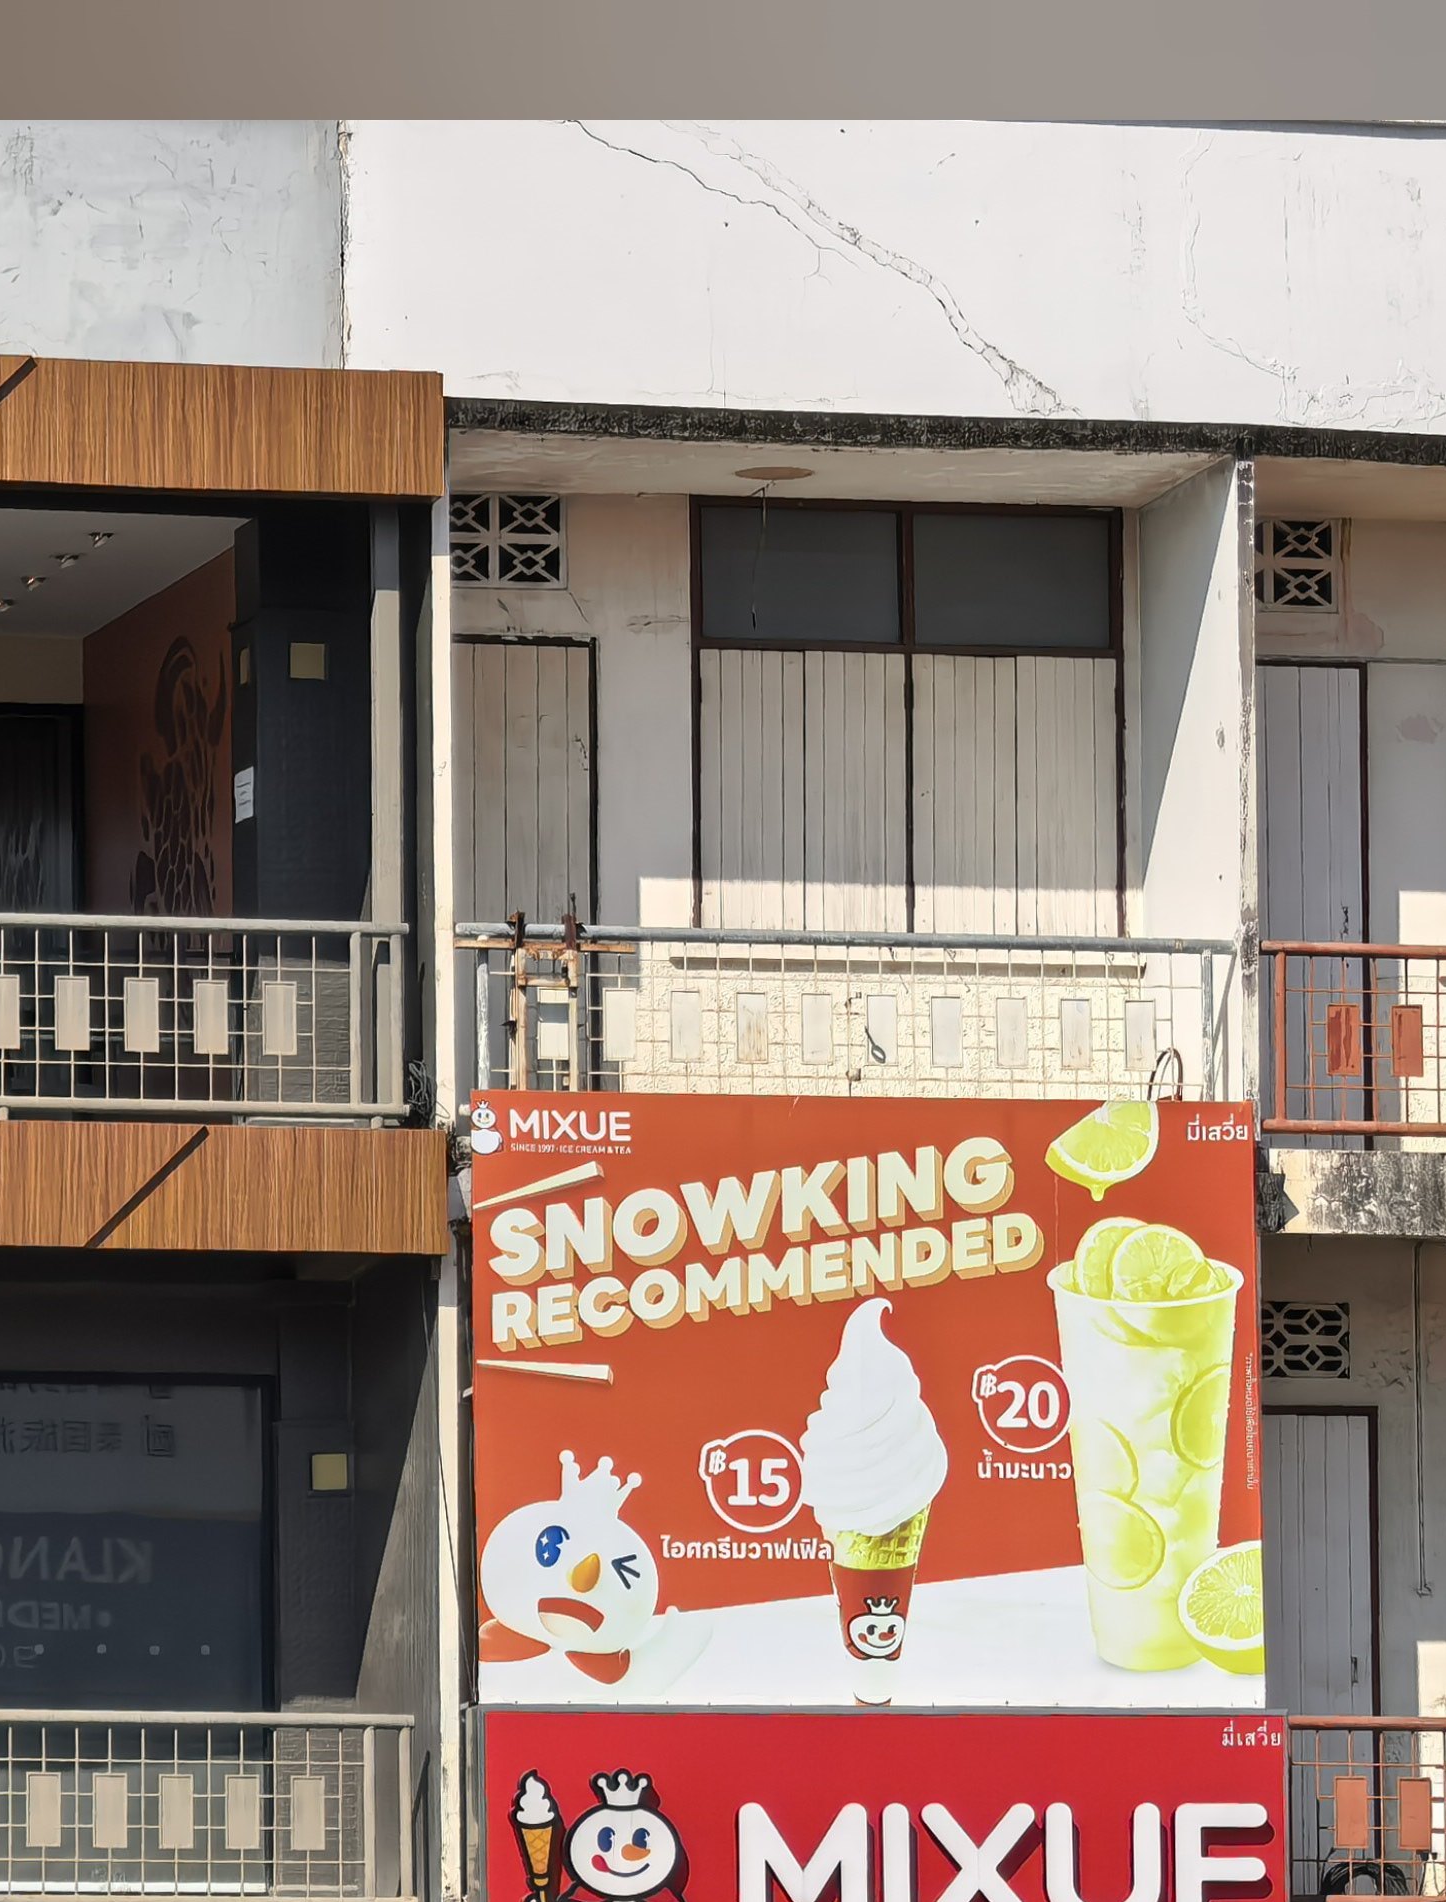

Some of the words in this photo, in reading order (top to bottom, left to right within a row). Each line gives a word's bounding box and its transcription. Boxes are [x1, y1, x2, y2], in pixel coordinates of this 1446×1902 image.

[509, 1109, 632, 1142] MIXUE
[511, 1142, 536, 1153] SINCE
[560, 1144, 573, 1154] ICE
[576, 1144, 606, 1154] CREAM
[489, 1136, 1016, 1283] SNOWKING
[491, 1211, 1044, 1350] RECOMMENDED
[977, 1449, 1073, 1480] น้ำมะนาว
